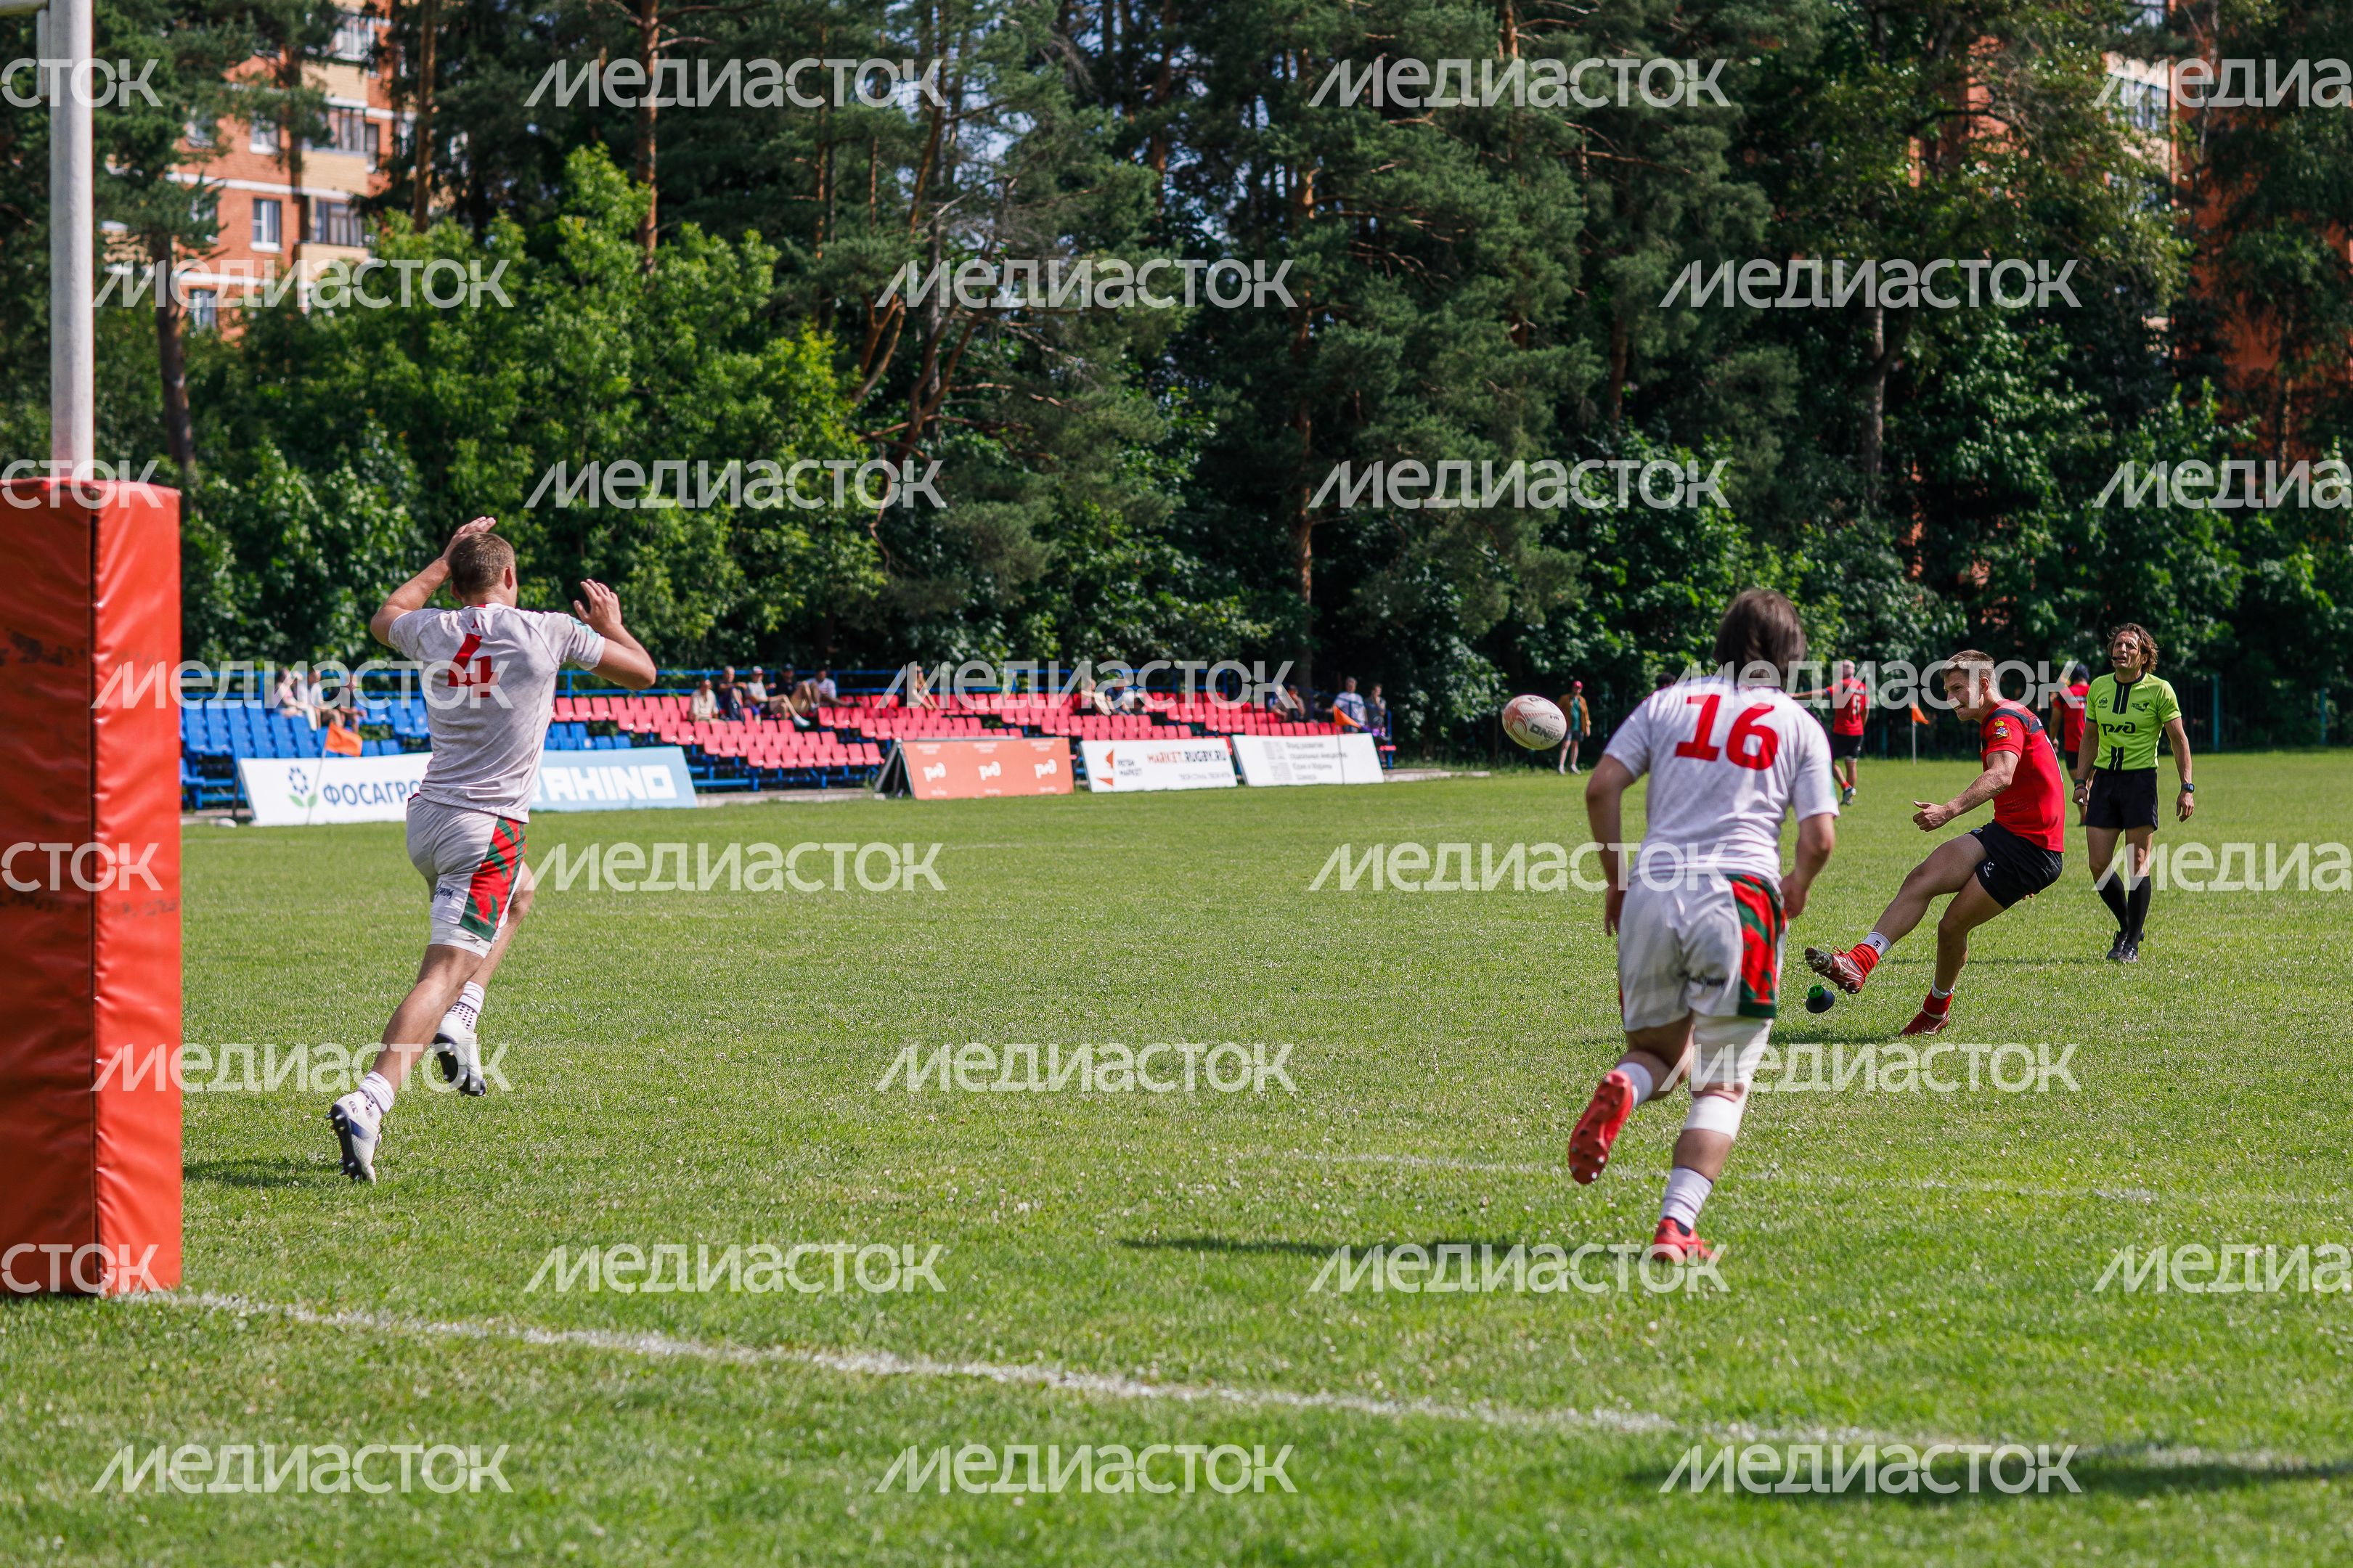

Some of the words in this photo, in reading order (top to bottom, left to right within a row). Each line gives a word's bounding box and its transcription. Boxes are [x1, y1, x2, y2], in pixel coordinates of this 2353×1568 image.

[448, 633, 499, 698] 4
[1675, 695, 1779, 770] 16
[540, 764, 677, 802] RHINO
